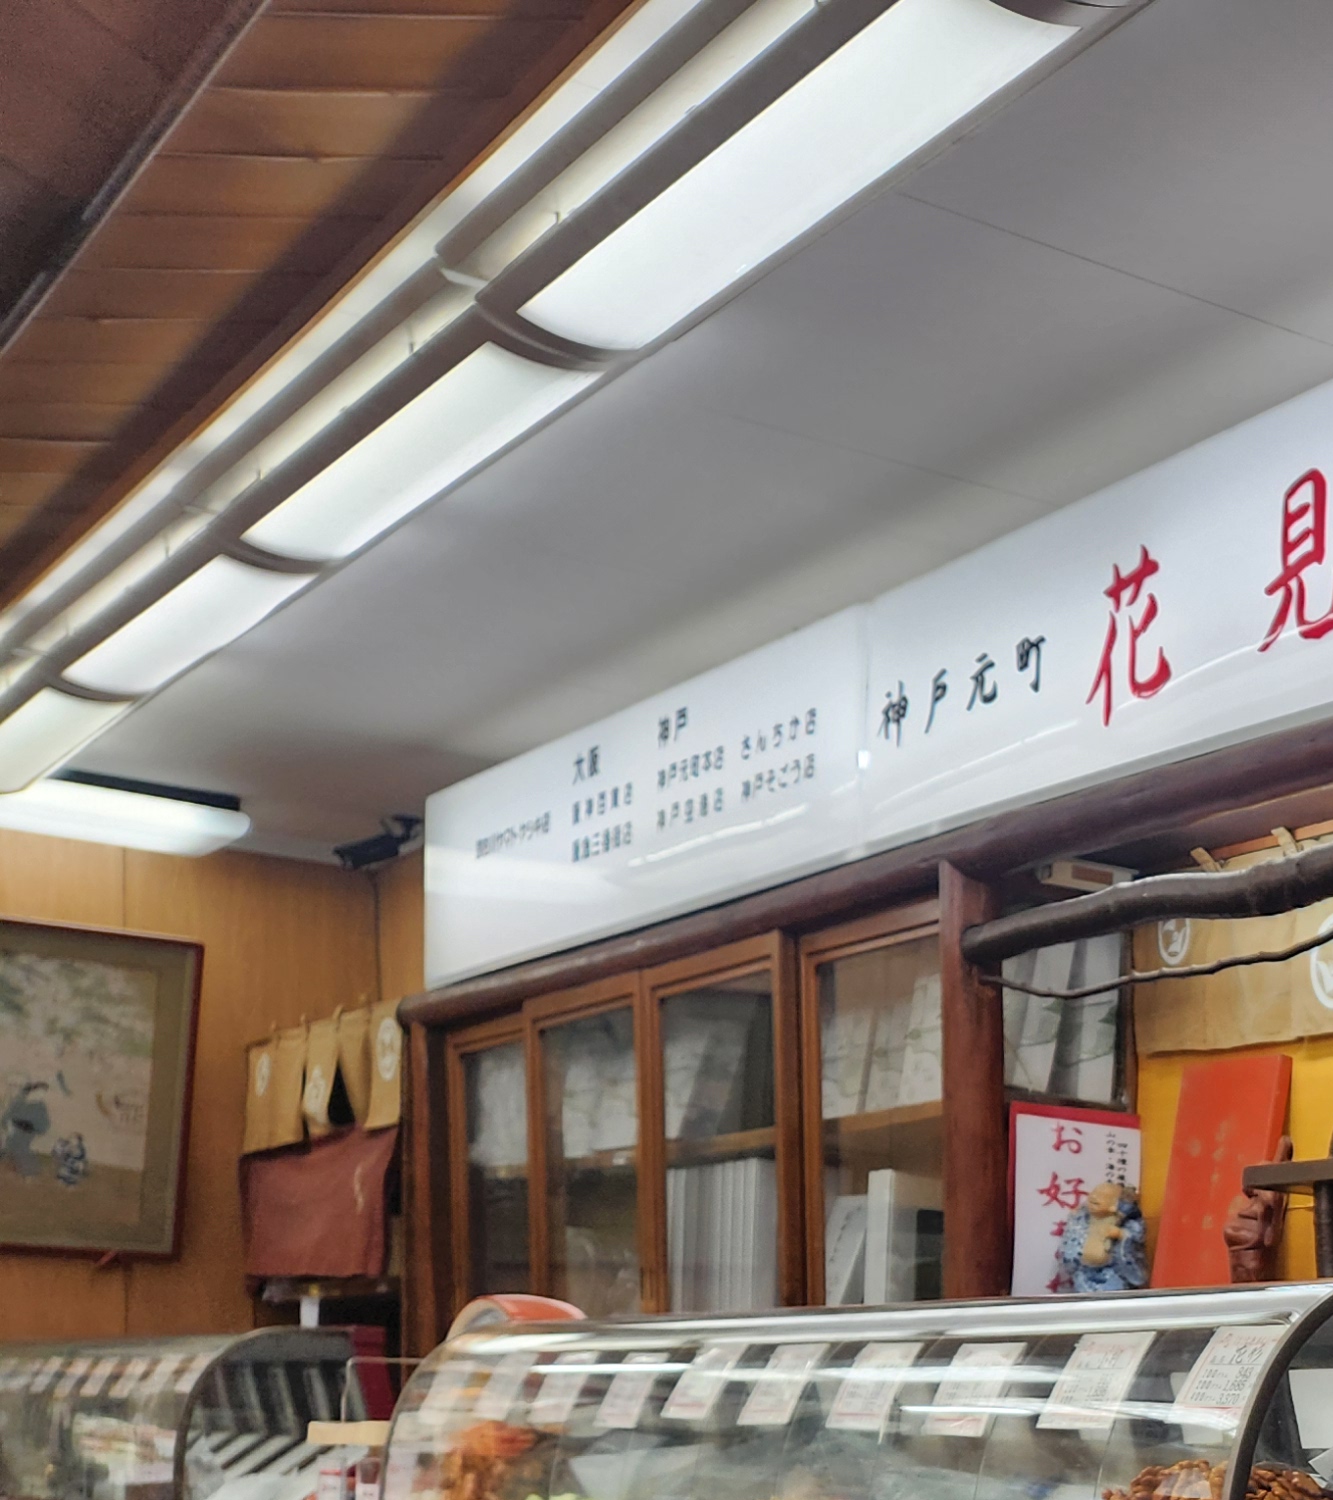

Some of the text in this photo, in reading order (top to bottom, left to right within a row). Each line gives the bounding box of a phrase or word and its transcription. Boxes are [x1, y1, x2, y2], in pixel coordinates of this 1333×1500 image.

[878, 635, 1046, 747] 神戸元町
[658, 707, 689, 747] 神戸
[572, 745, 600, 786] 大阪
